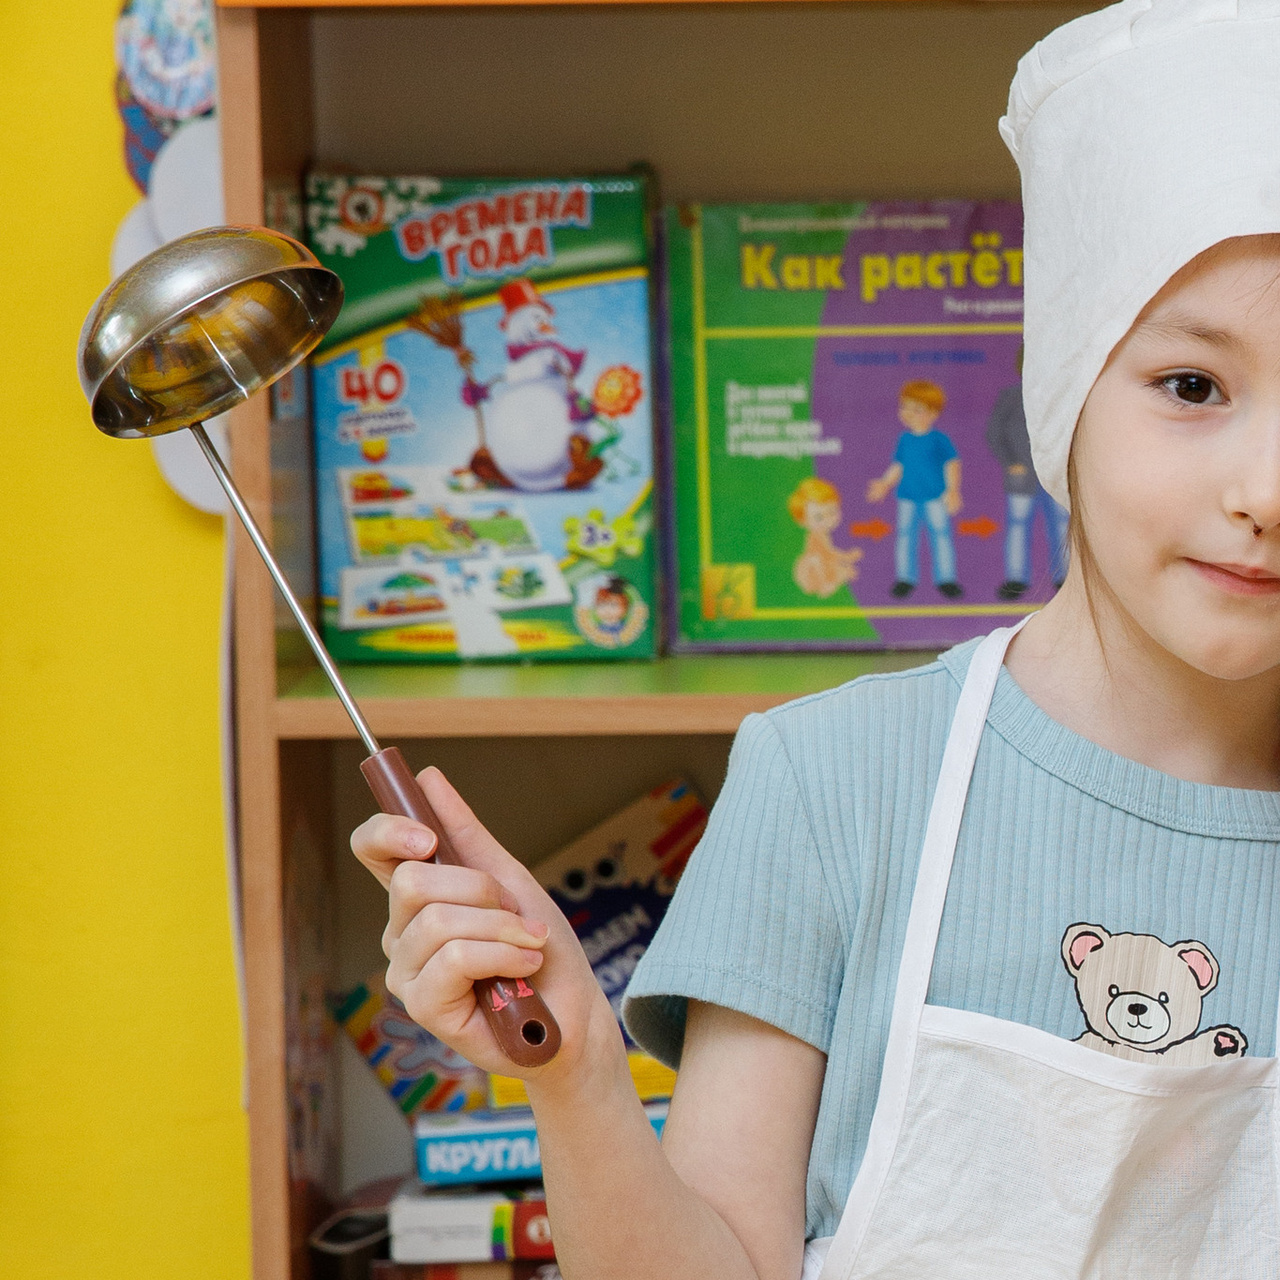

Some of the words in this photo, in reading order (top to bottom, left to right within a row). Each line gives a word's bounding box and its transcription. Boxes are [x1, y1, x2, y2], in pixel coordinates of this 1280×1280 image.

[401, 187, 588, 255] ВРЕМЕНА
[445, 226, 548, 279] ГОДА
[740, 243, 846, 290] Как
[860, 231, 1024, 303] растёт
[341, 361, 406, 403] 40
